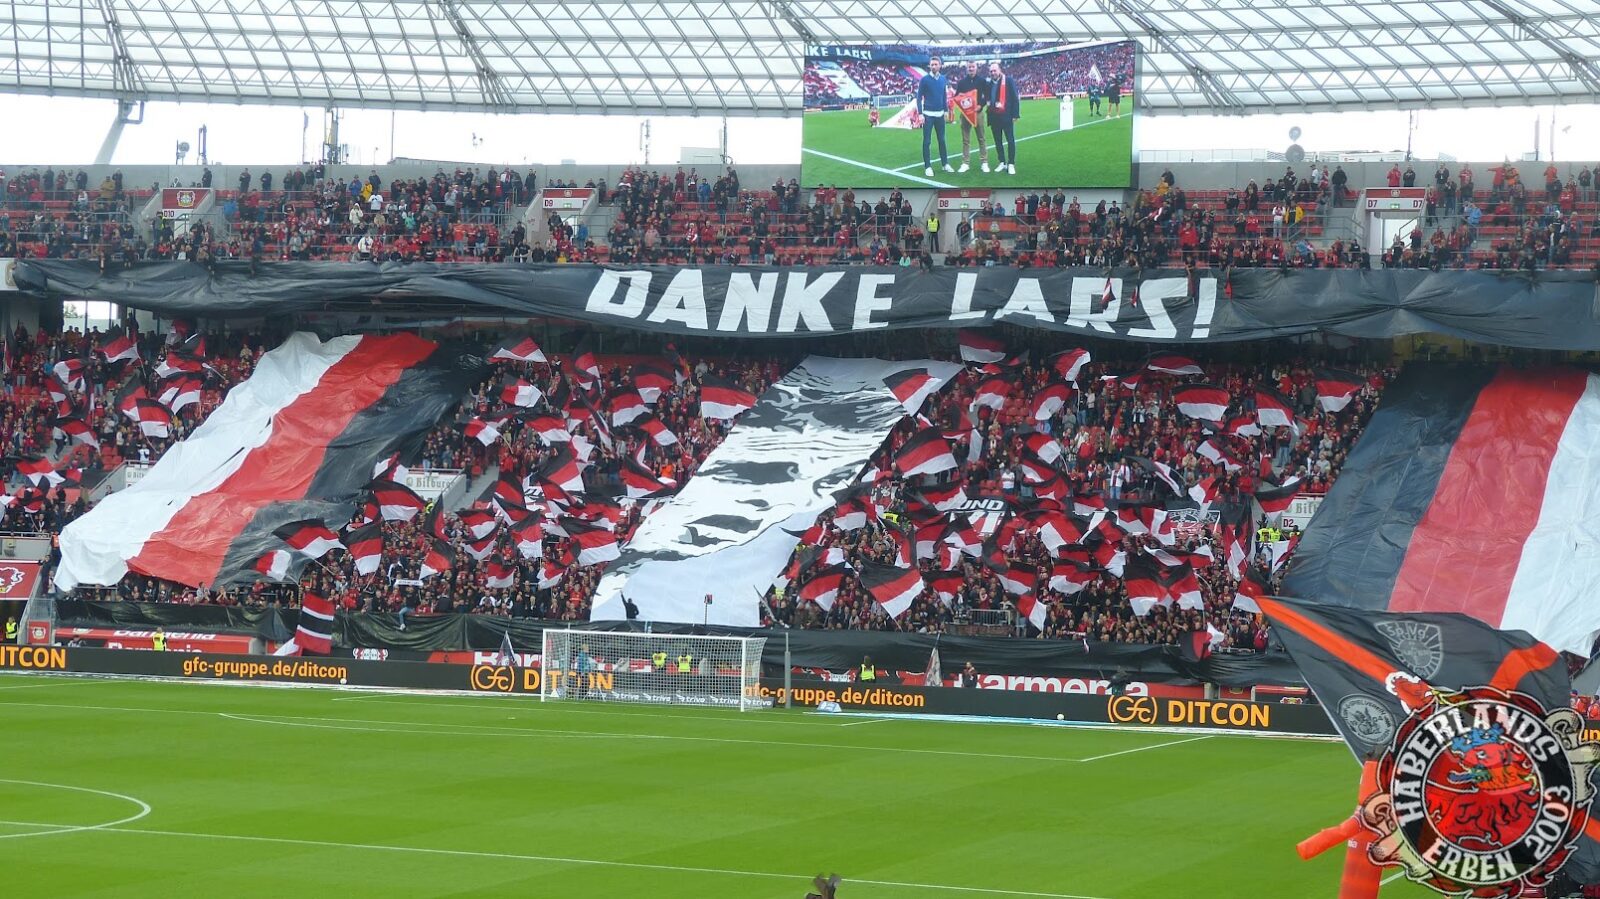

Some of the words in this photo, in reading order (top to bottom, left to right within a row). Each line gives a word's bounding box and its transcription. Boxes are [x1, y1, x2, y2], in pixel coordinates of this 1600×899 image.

[1368, 200, 1378, 208] D7
[585, 268, 896, 333] DANKE
[948, 272, 1218, 338] LARS!
[1283, 519, 1294, 528] D2
[183, 656, 347, 679] gfc-gruppe.de/ditcon
[745, 683, 924, 707] gfc-guppe.de/ditcon
[1168, 701, 1270, 727] DITCON
